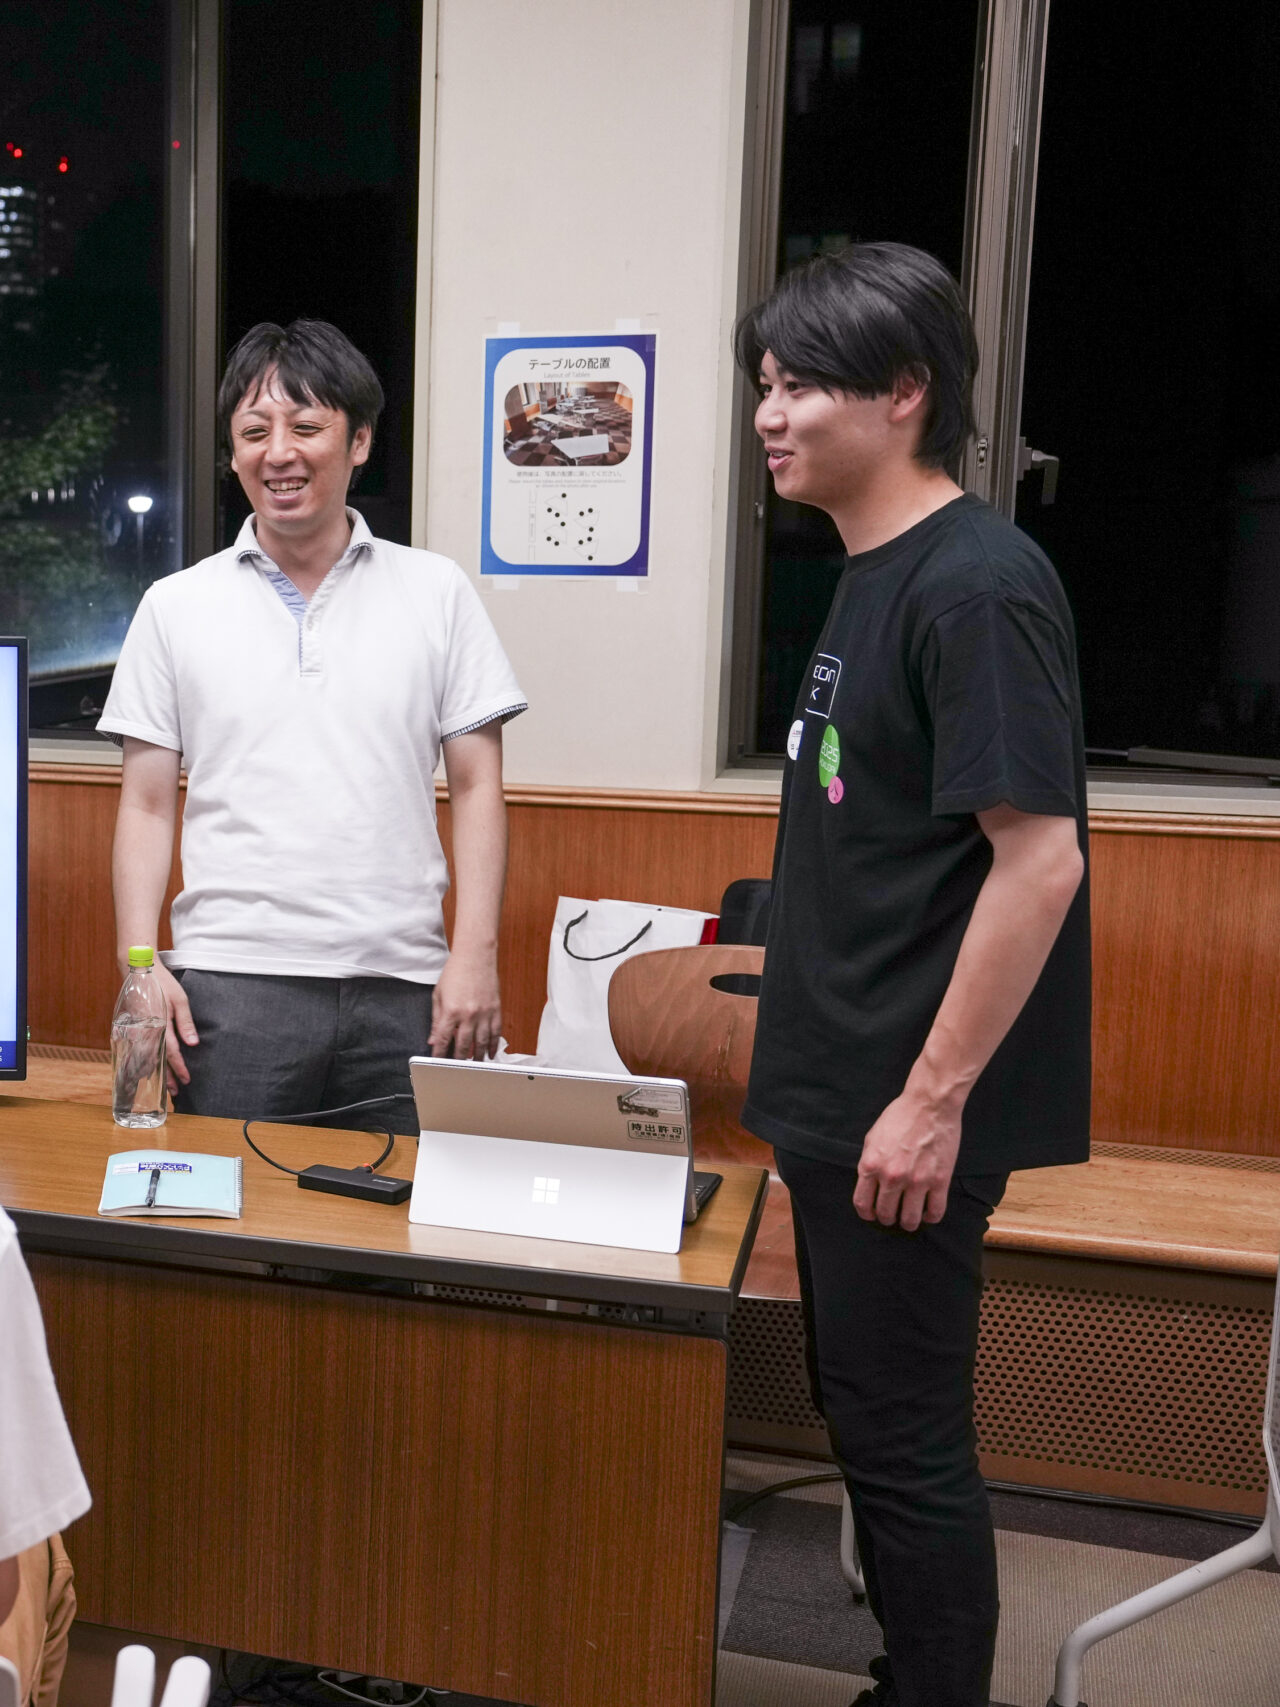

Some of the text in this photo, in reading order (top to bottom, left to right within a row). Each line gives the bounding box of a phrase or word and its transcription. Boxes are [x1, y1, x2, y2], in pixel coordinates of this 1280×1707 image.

[529, 357, 610, 370] テーブルの配置
